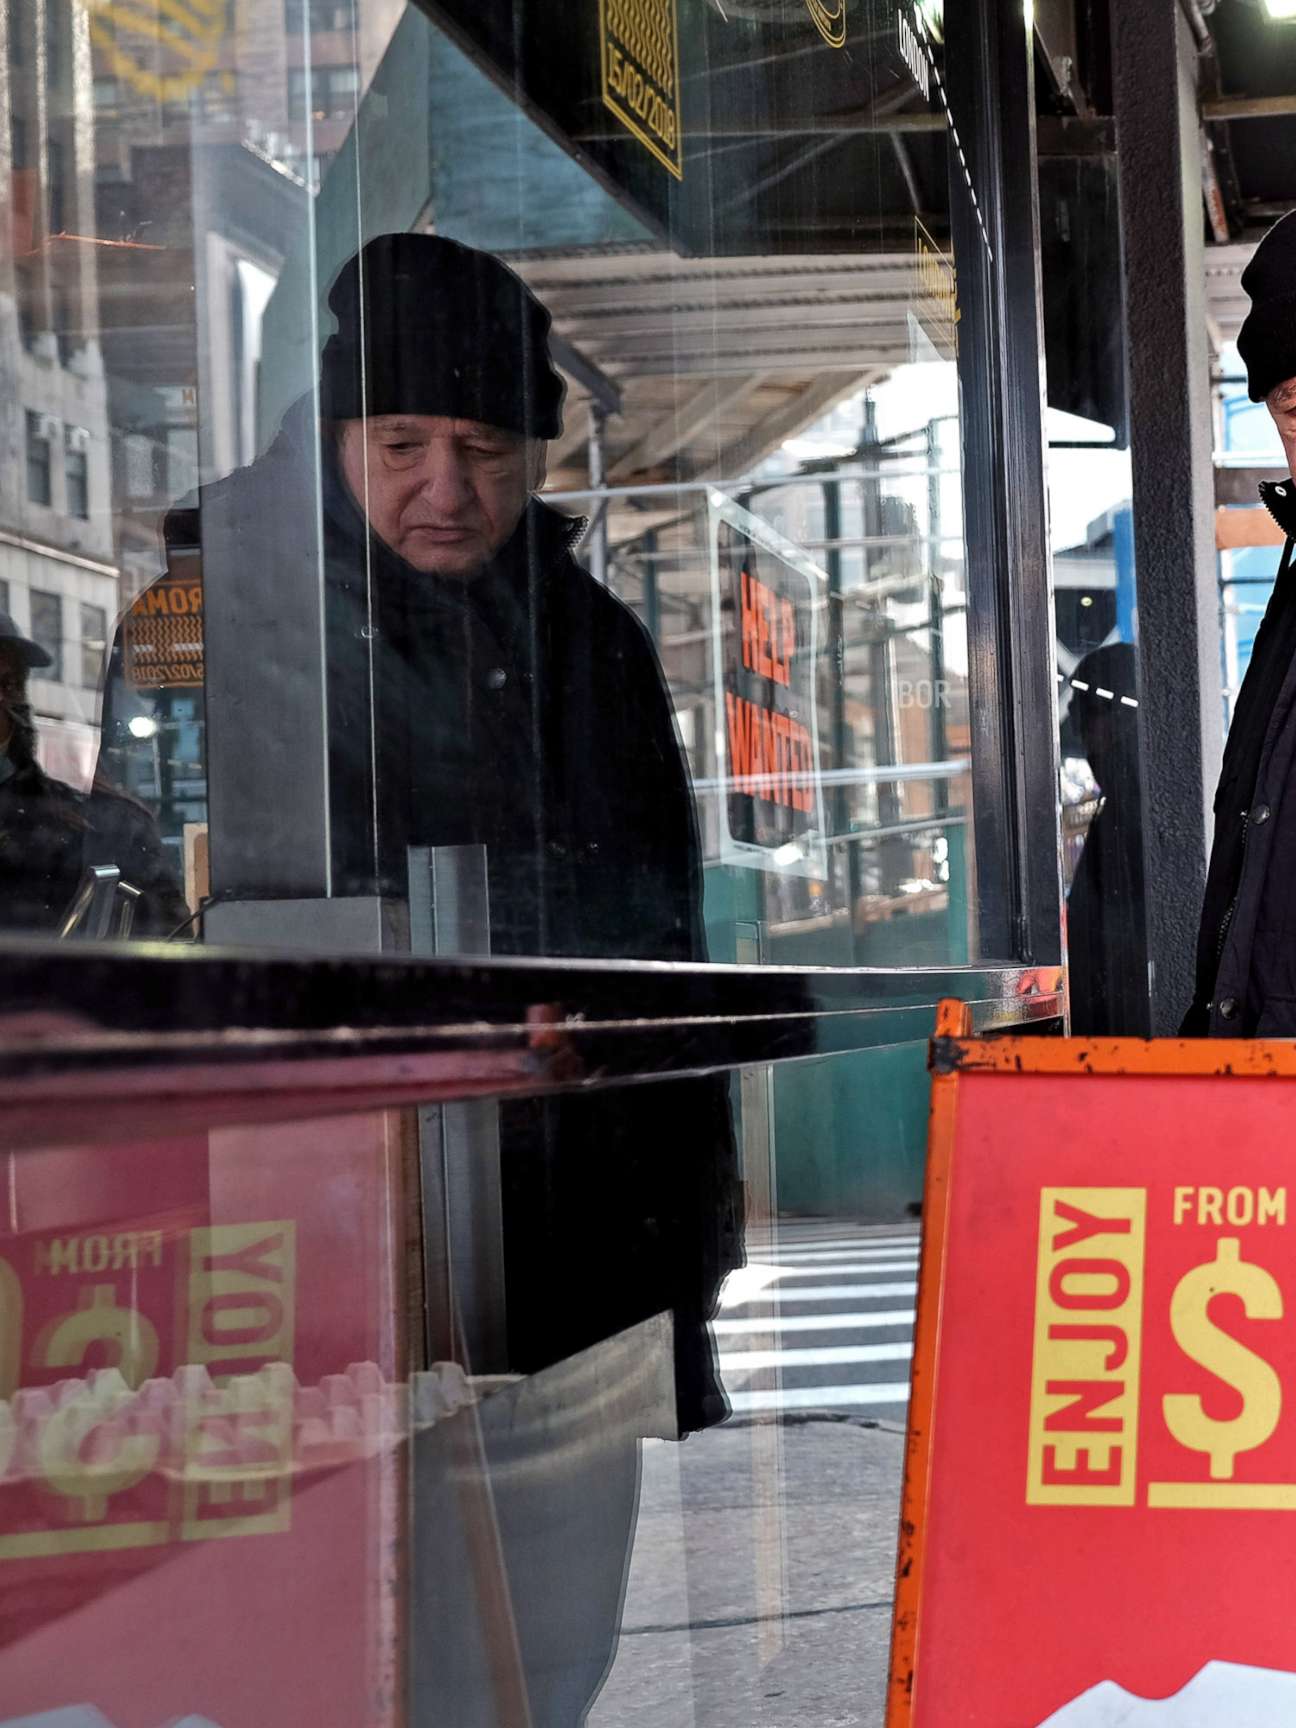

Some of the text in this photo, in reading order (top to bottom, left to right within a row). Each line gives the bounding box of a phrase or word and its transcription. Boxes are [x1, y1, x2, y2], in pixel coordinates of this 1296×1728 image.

[897, 8, 930, 102] LONDON
[741, 571, 795, 688] HELP
[726, 691, 811, 813] WANTED
[1173, 1185, 1287, 1226] FROM
[1041, 1198, 1132, 1487] ENJOY
